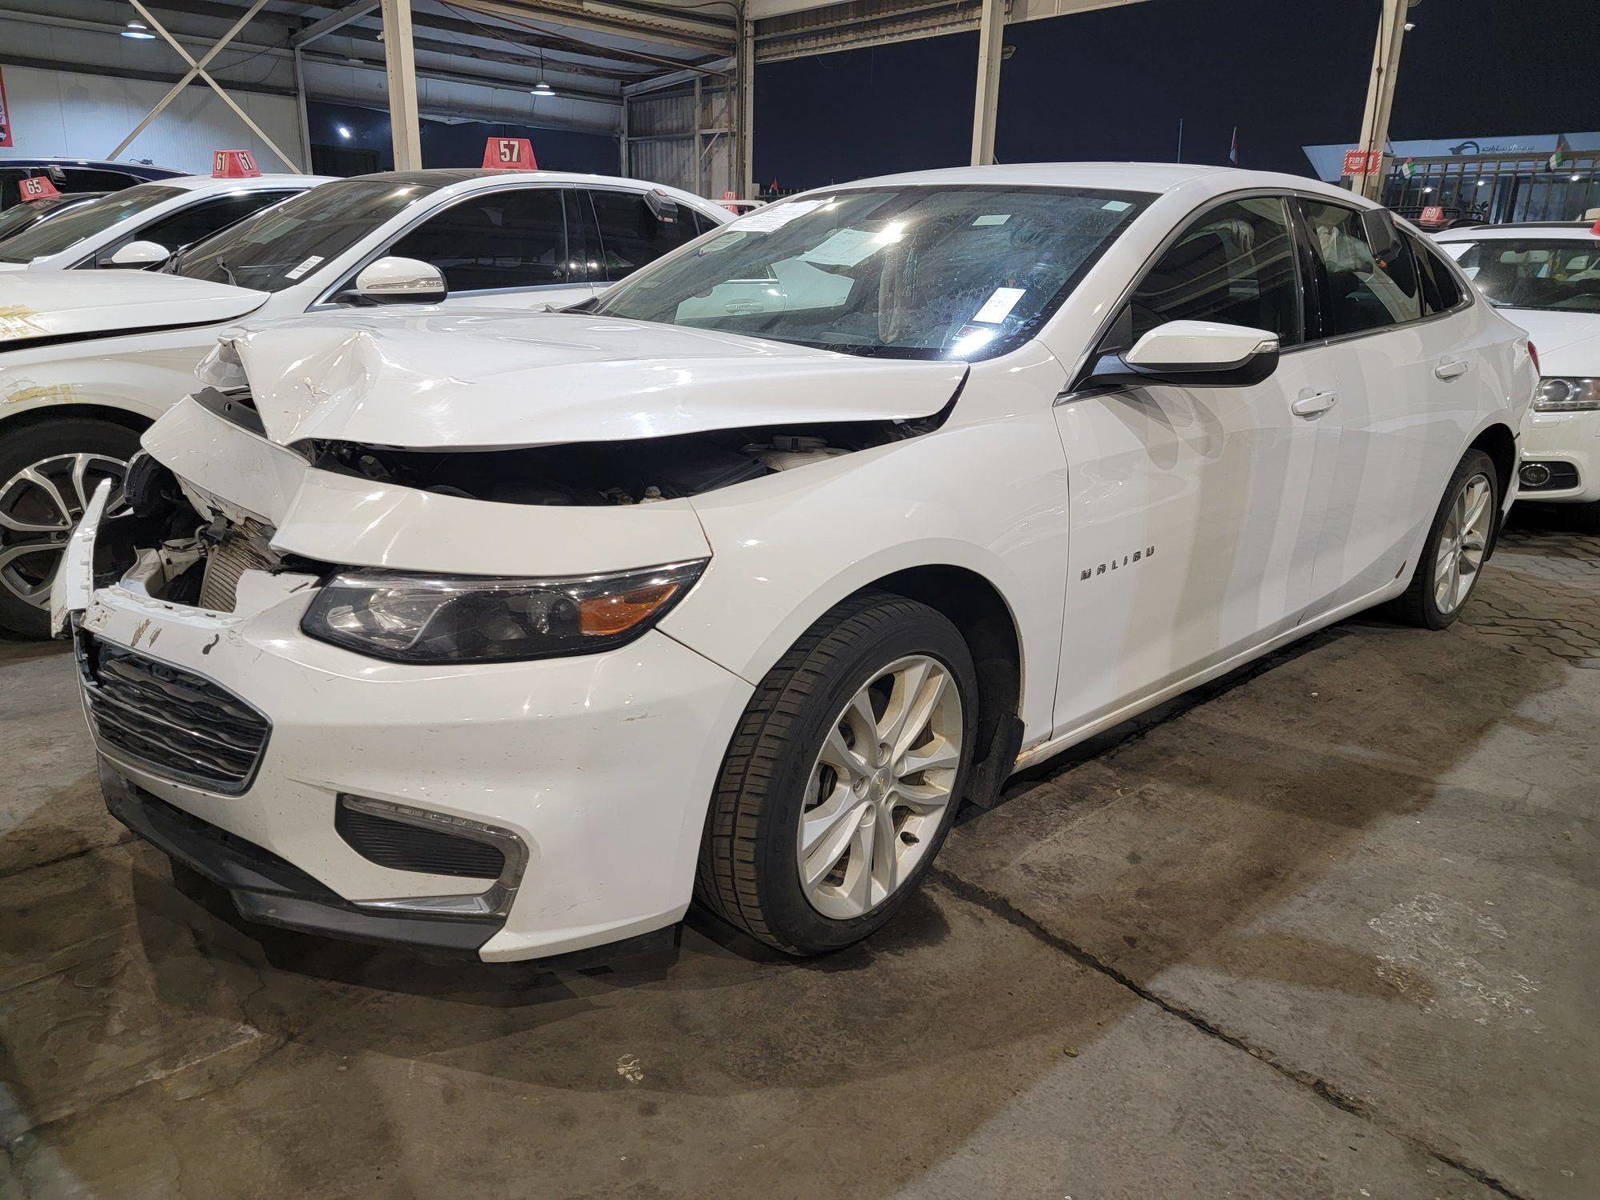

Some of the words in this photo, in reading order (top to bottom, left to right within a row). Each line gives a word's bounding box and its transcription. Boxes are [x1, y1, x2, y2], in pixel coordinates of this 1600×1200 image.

[499, 140, 519, 162] 57
[216, 153, 226, 170] 61
[238, 152, 253, 170] 61
[26, 180, 42, 194] 65
[1080, 545, 1155, 581] MALIBU
